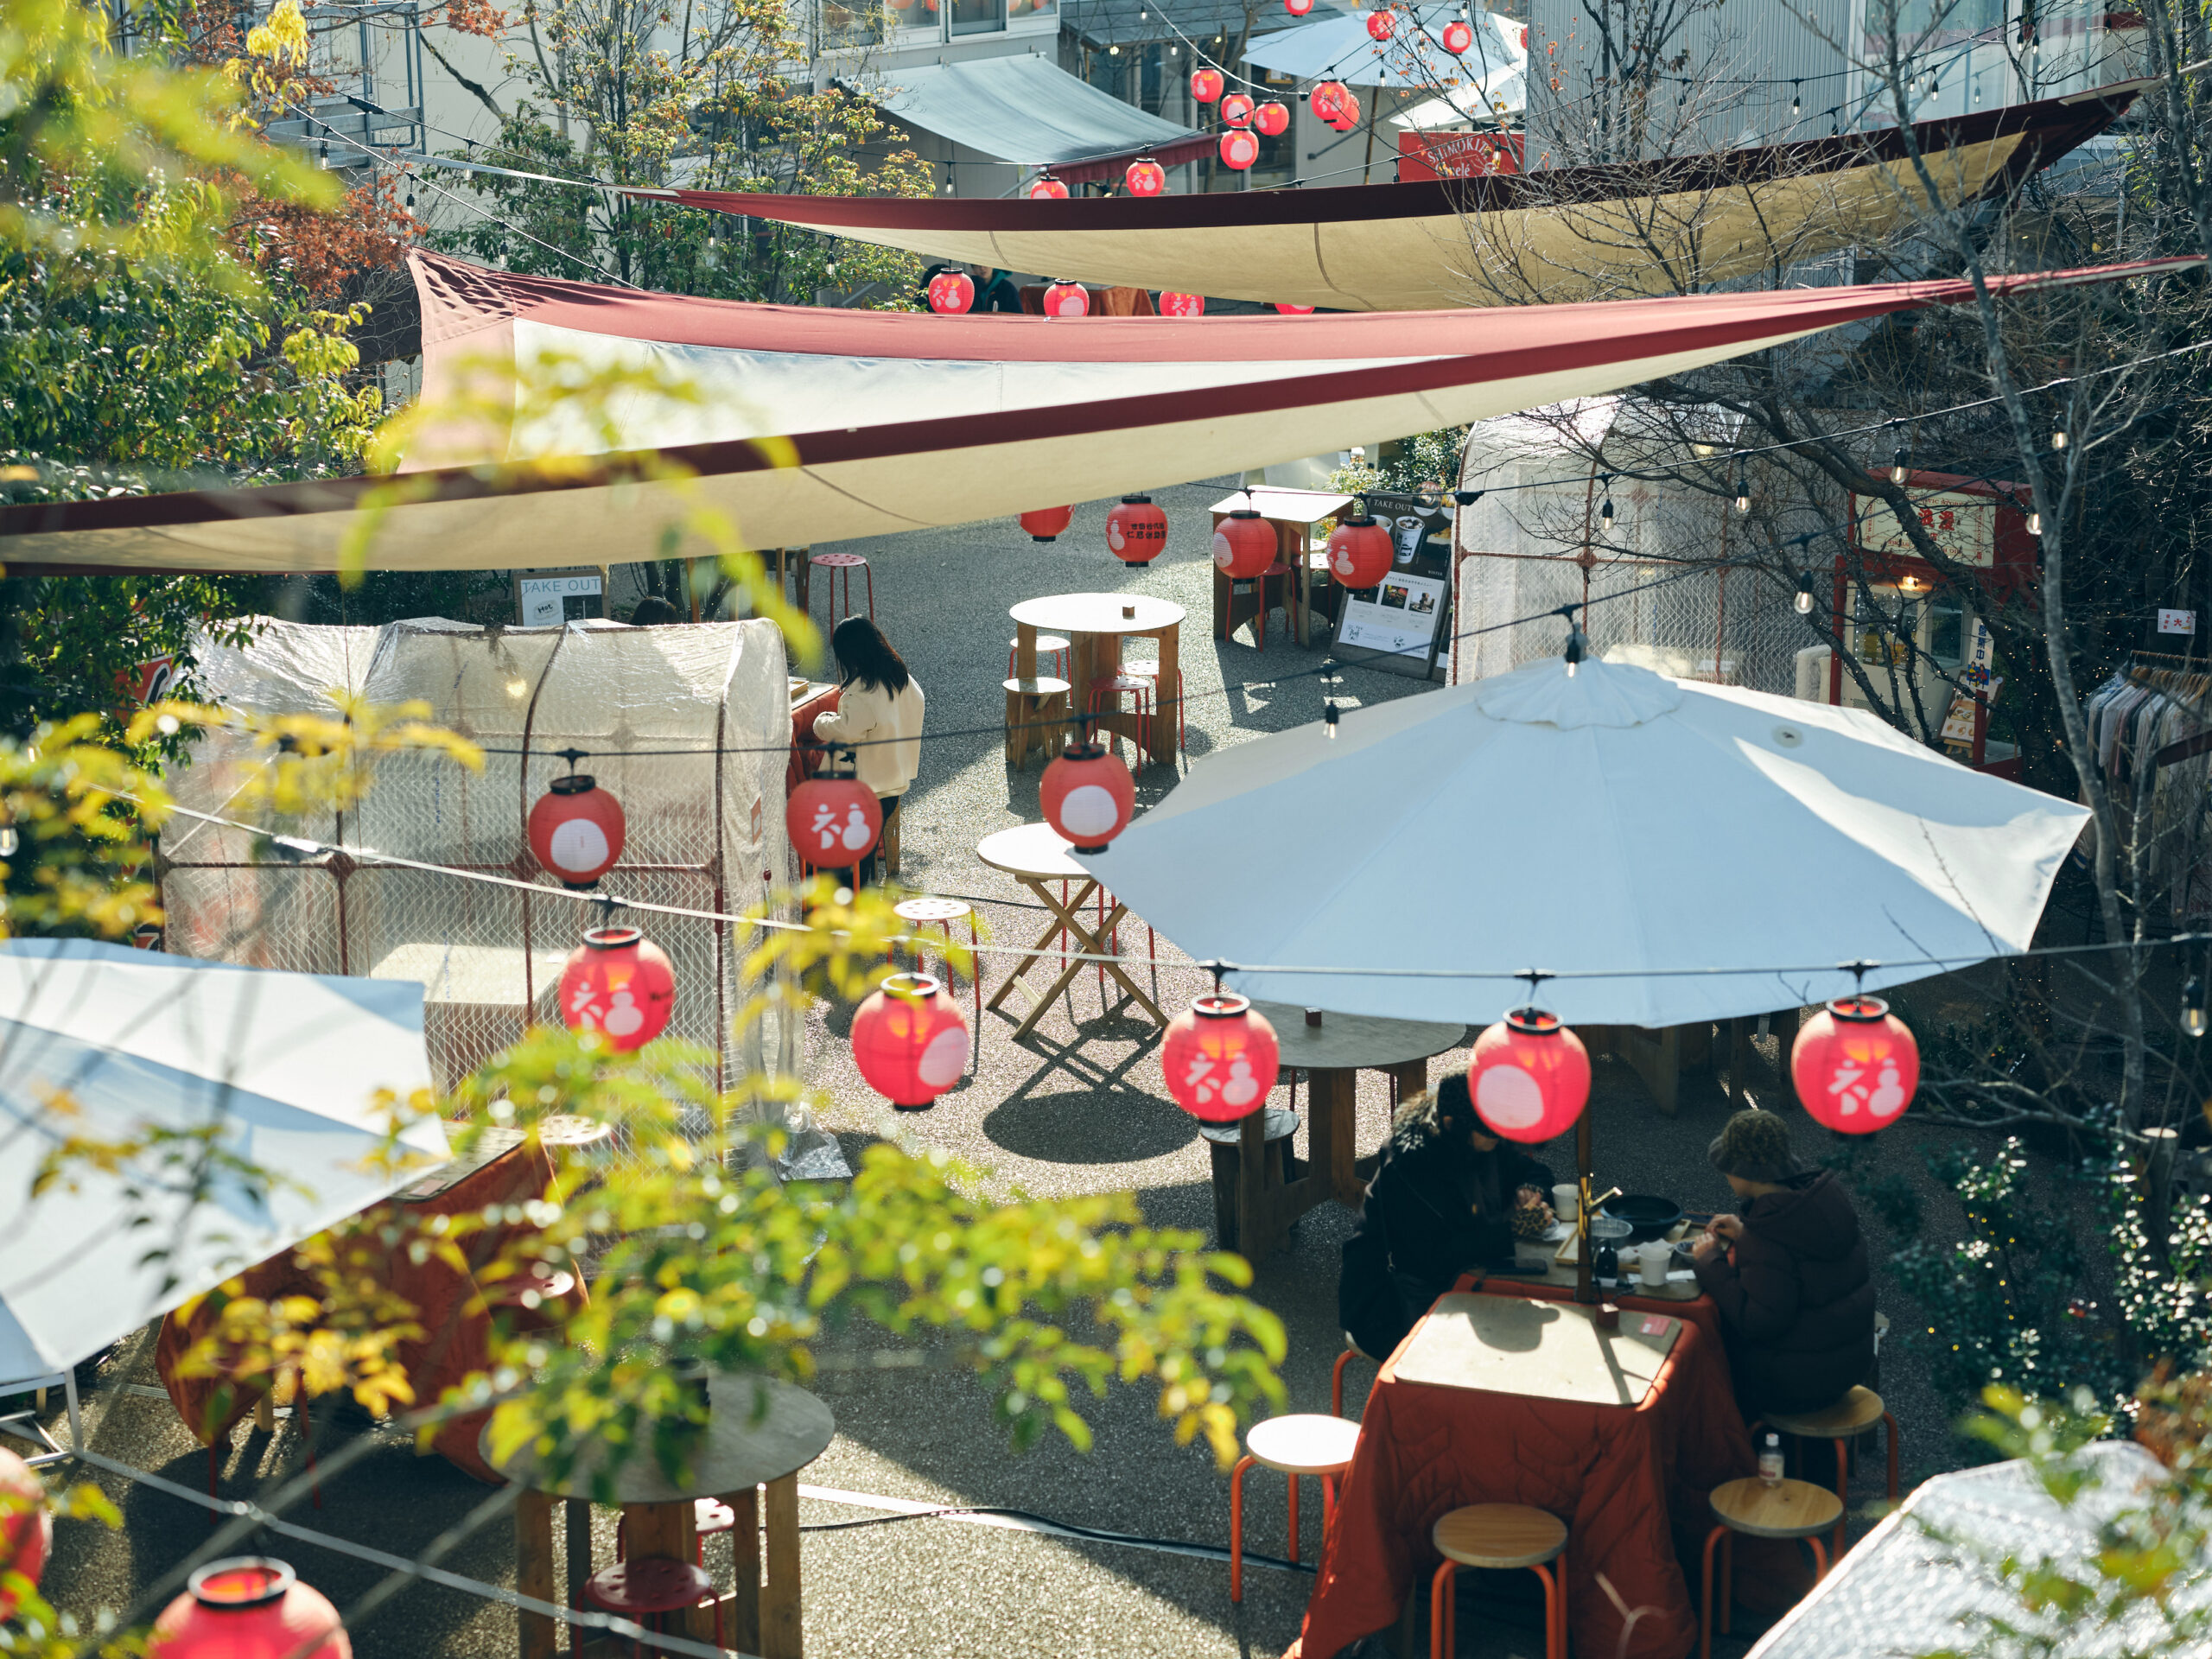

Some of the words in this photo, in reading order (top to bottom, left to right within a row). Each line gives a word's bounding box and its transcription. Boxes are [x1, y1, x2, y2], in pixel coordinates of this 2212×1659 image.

[1427, 137, 1492, 163] SHIMOKIT
[1435, 163, 1470, 177] Cnelé
[1374, 499, 1393, 510] TAKE
[1395, 503, 1413, 512] OUT
[522, 581, 562, 594] TAKE
[568, 578, 600, 591] OUT
[537, 603, 553, 613] Hot
